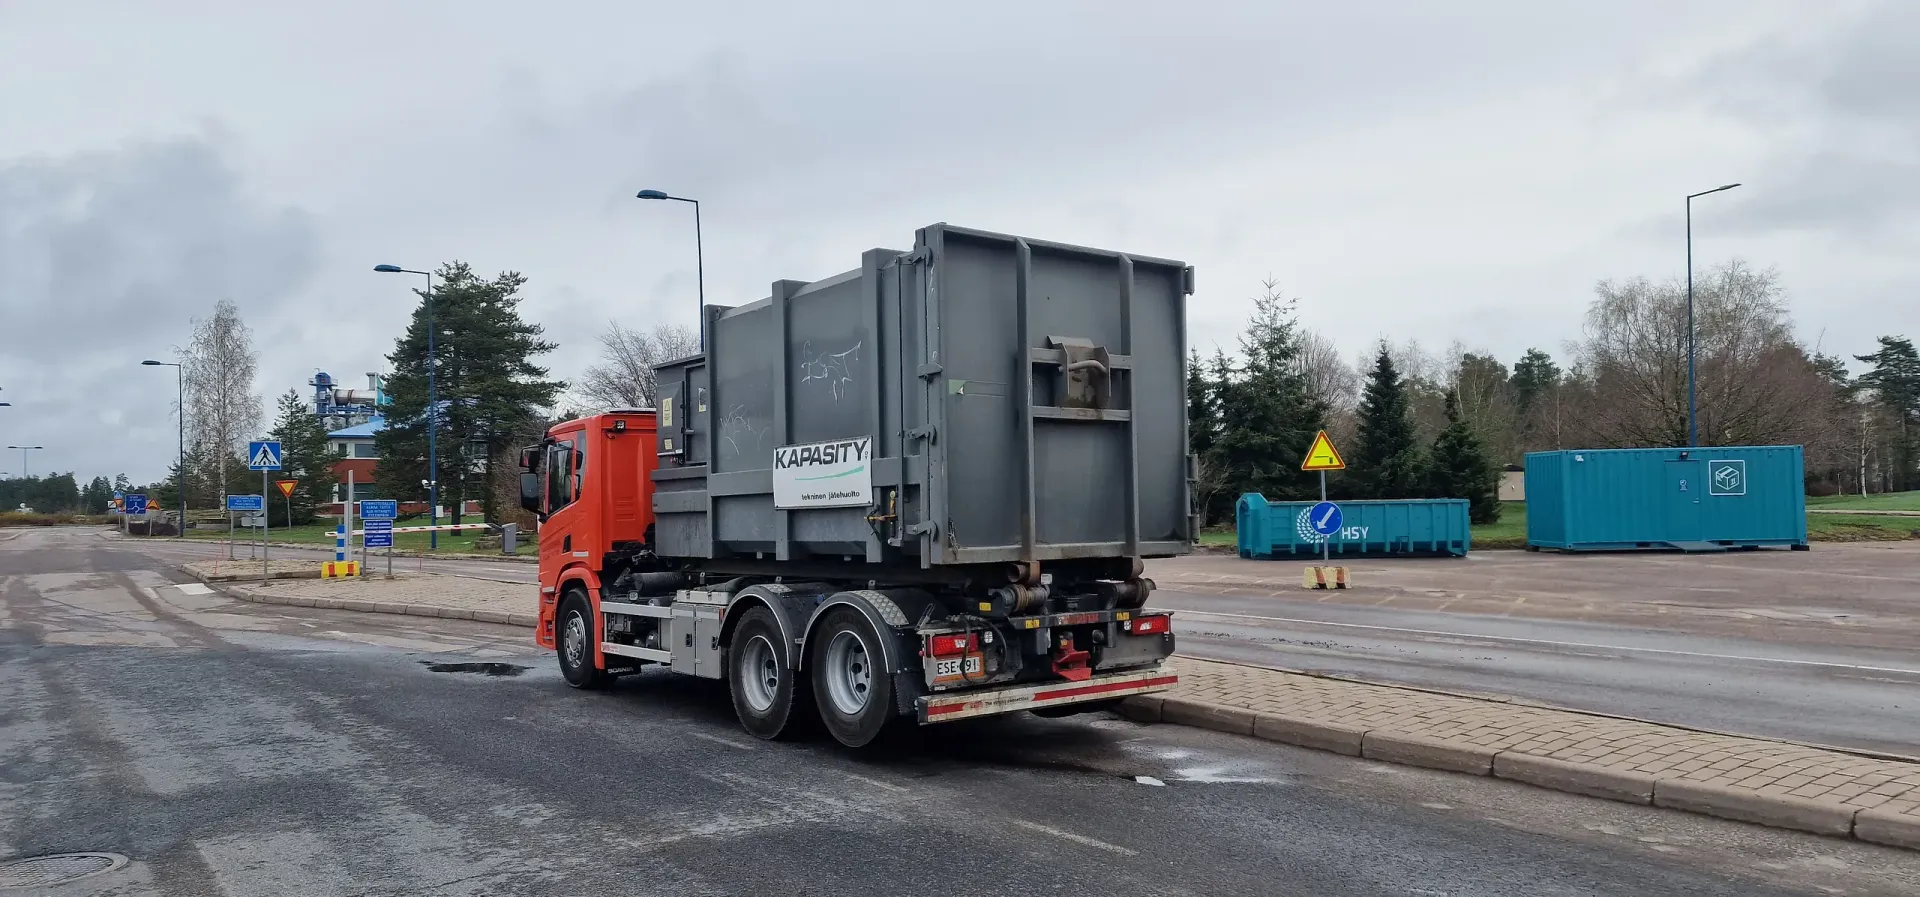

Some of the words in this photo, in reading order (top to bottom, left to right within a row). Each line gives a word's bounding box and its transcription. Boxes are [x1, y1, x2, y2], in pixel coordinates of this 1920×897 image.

[775, 441, 867, 469] KAPASITY
[801, 493, 826, 501] tekninen
[828, 490, 860, 500] jätehuolto
[1341, 526, 1369, 539] HSY
[937, 659, 976, 674] ESE-91
